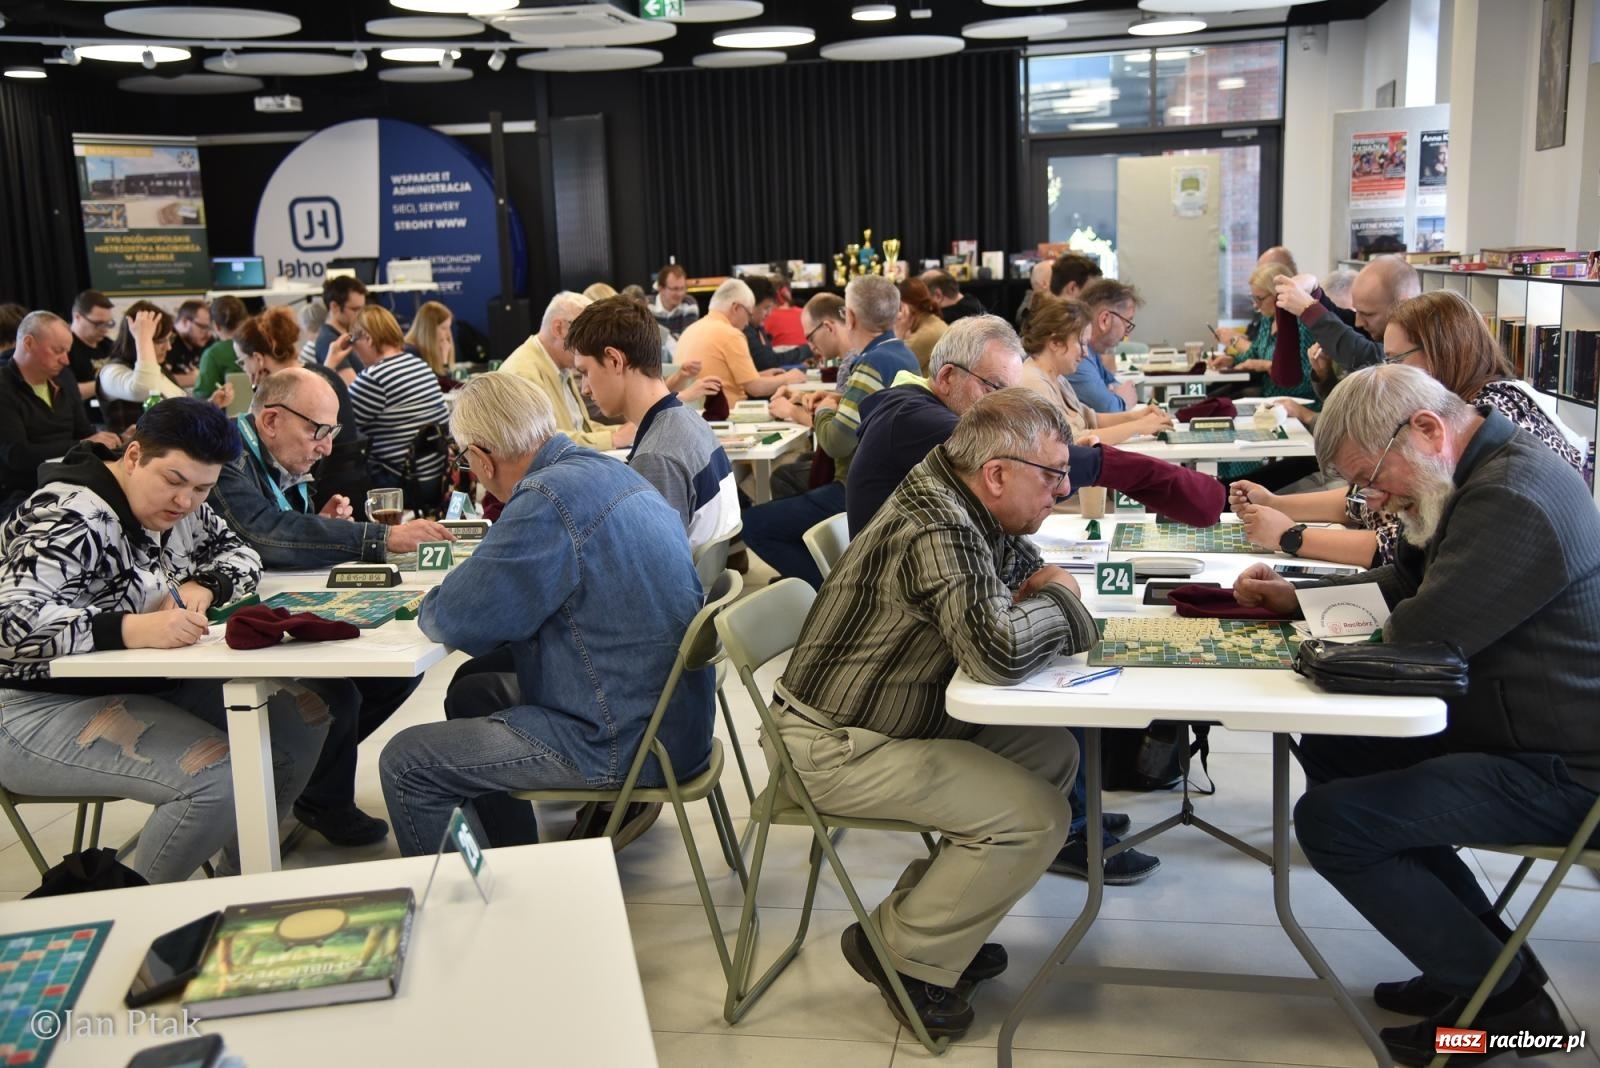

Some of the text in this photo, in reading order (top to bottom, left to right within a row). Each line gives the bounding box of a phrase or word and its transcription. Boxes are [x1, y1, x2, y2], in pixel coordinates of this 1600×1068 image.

[390, 171, 451, 184] WSPARCIE IT
[392, 181, 472, 196] ADMINISTRACJA
[419, 201, 460, 213] SERWERY
[394, 217, 467, 231] STRONY WWW
[1189, 383, 1202, 395] 21
[421, 546, 447, 567] 27
[1101, 567, 1130, 591] 24
